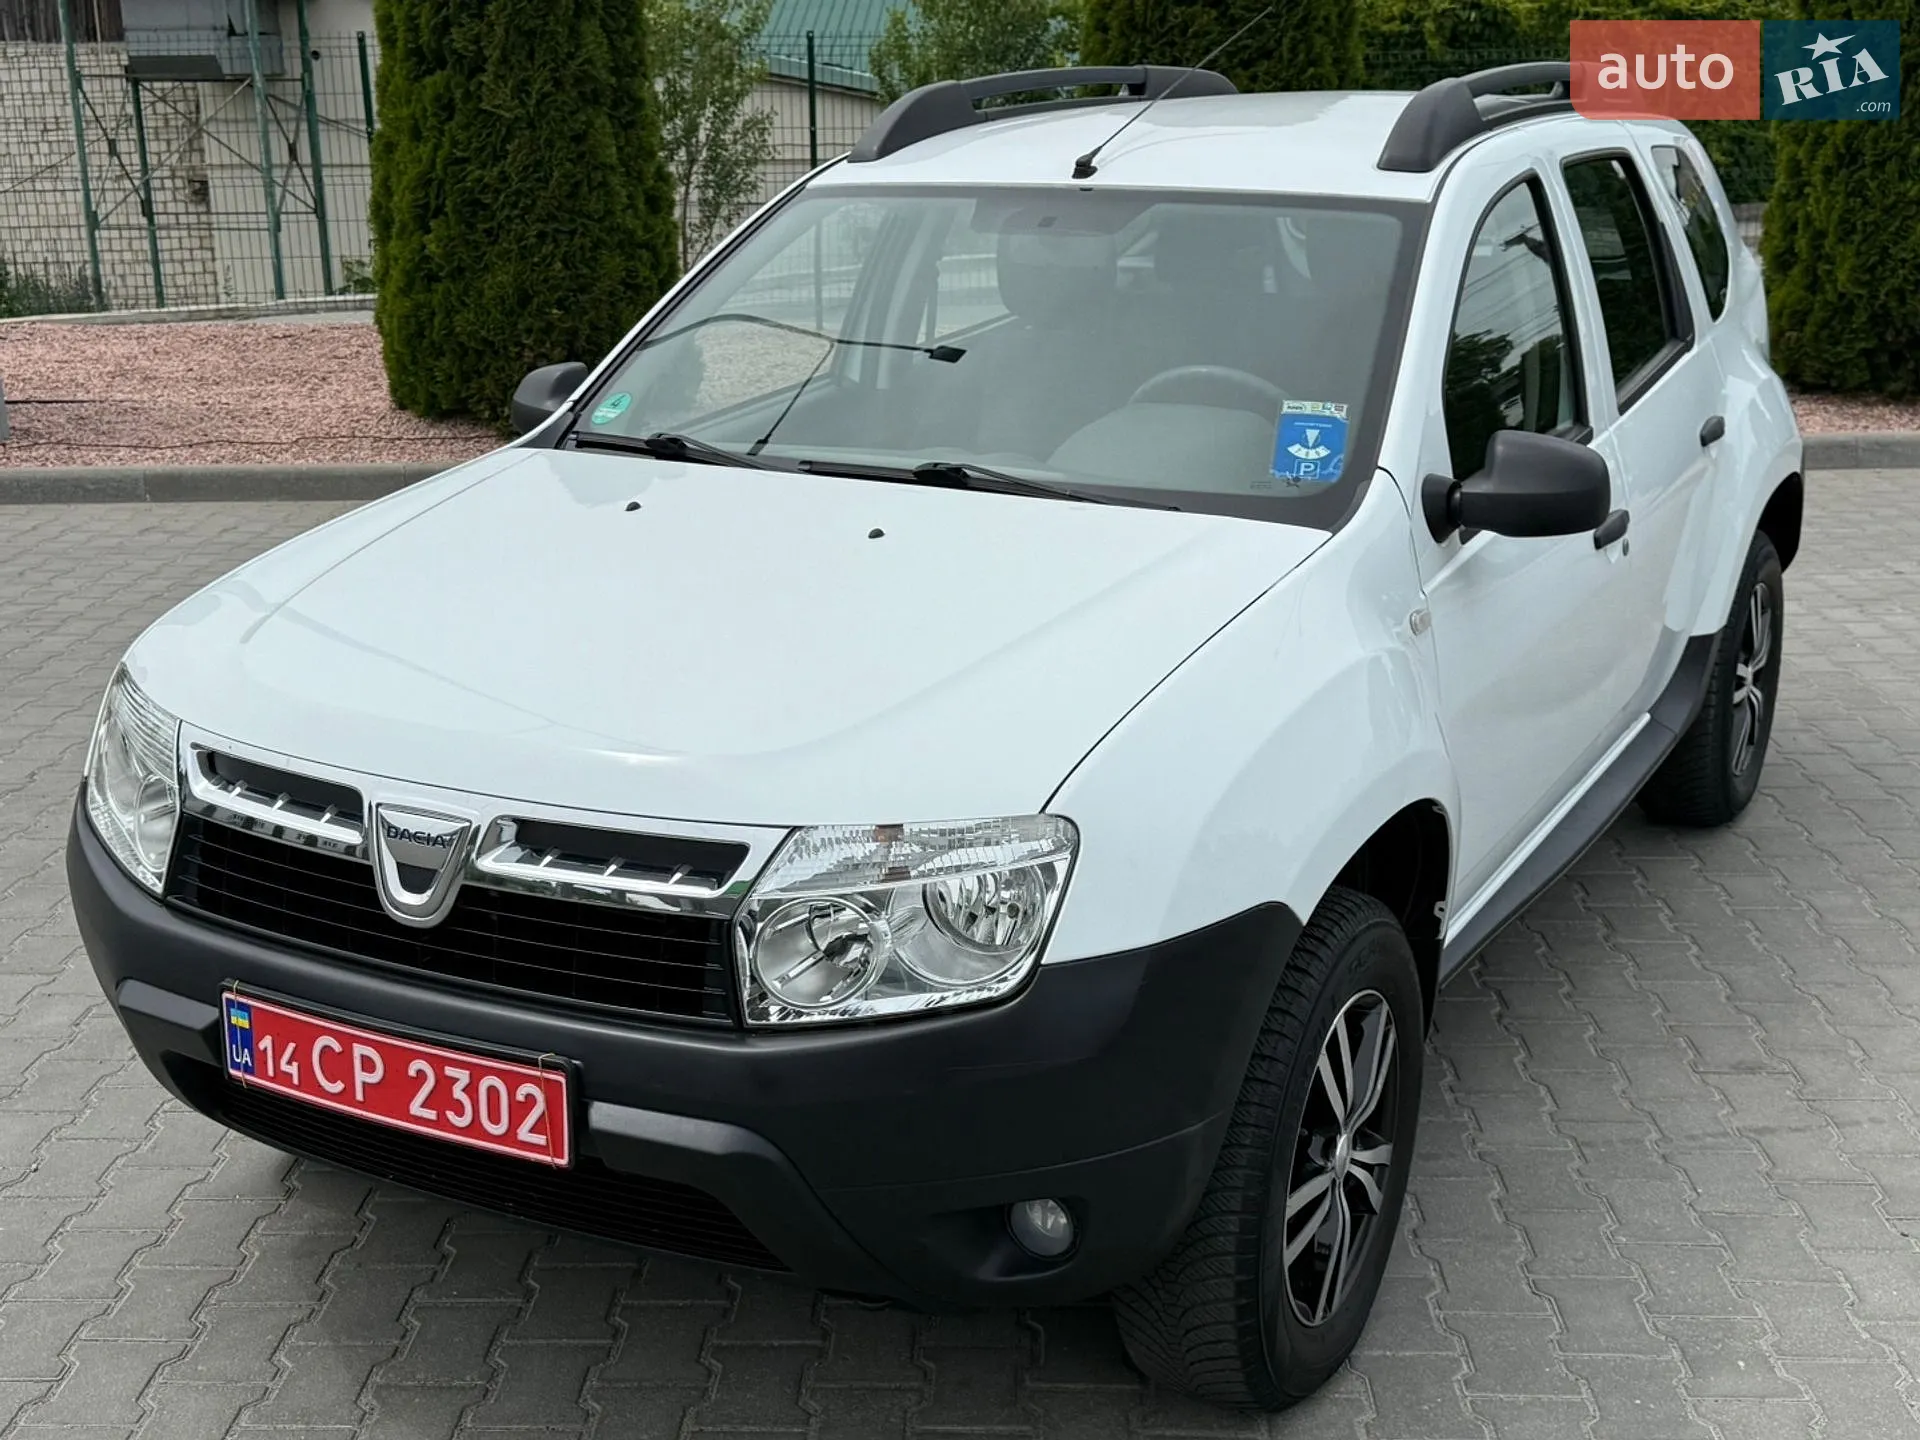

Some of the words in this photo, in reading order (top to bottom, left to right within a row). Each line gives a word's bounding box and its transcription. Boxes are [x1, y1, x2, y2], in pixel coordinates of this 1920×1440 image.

[1299, 462, 1315, 476] P
[386, 825, 447, 849] DACIA
[232, 1043, 252, 1067] UA
[257, 1034, 300, 1085] 14
[311, 1035, 385, 1102] CP
[407, 1059, 548, 1146] 2302
